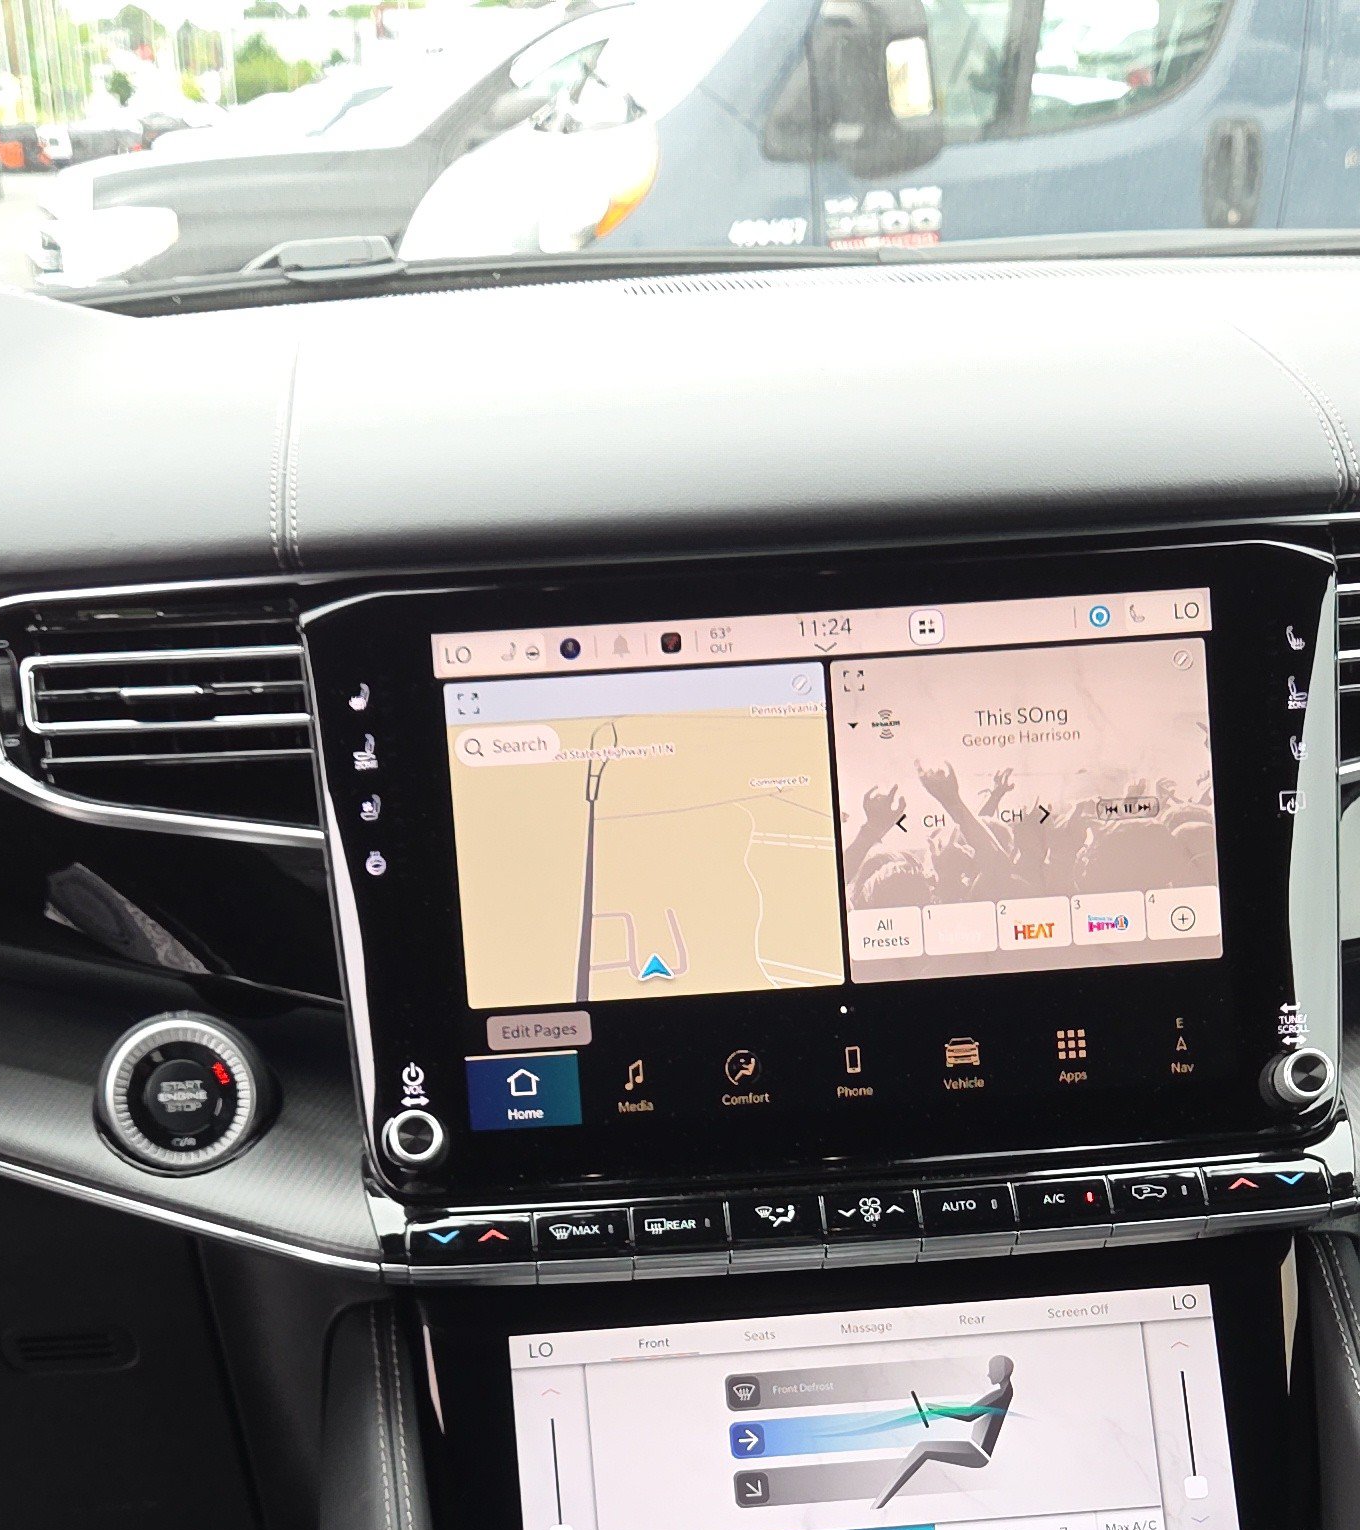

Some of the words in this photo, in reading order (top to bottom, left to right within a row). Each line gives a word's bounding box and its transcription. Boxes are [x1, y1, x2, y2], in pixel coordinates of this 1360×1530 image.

[1173, 601, 1200, 621] LO
[797, 618, 853, 638] 11:24
[445, 646, 472, 664] LO
[710, 643, 733, 654] OUT
[976, 709, 1012, 727] This
[493, 736, 548, 754] Search
[962, 731, 1016, 748] George
[1019, 730, 1081, 744] Harrison
[923, 814, 946, 828] CH
[1000, 809, 1024, 823] CH
[1073, 900, 1082, 910] 3
[1148, 894, 1156, 904] 4
[1000, 905, 1007, 915] 2
[877, 919, 894, 931] All
[1014, 922, 1055, 940] HEAT
[863, 935, 911, 948] Presets
[501, 1026, 529, 1039] Edit
[534, 1022, 578, 1041] Pages
[1278, 1024, 1310, 1034] SCROLL
[1171, 1060, 1194, 1074] Nav
[943, 1075, 985, 1090] Vehicle
[1059, 1069, 1087, 1084] Apps
[402, 1084, 425, 1096] VOL
[837, 1083, 874, 1099] Phone
[721, 1091, 770, 1106] Comfort
[507, 1106, 545, 1120] Home
[618, 1100, 655, 1113] Media
[942, 1199, 977, 1212] AUTO
[1043, 1193, 1066, 1205] A/C
[572, 1223, 600, 1236] MAX
[666, 1218, 697, 1232] REAR
[529, 1341, 554, 1359] LO
[638, 1337, 670, 1350] Front
[744, 1330, 776, 1342] Seats
[840, 1320, 893, 1335] Massage
[959, 1313, 986, 1326] Rear
[1047, 1307, 1089, 1319] Screen
[1091, 1303, 1110, 1316] Off
[1172, 1293, 1198, 1312] LO
[772, 1384, 798, 1395] Front
[799, 1381, 835, 1394] Defrost
